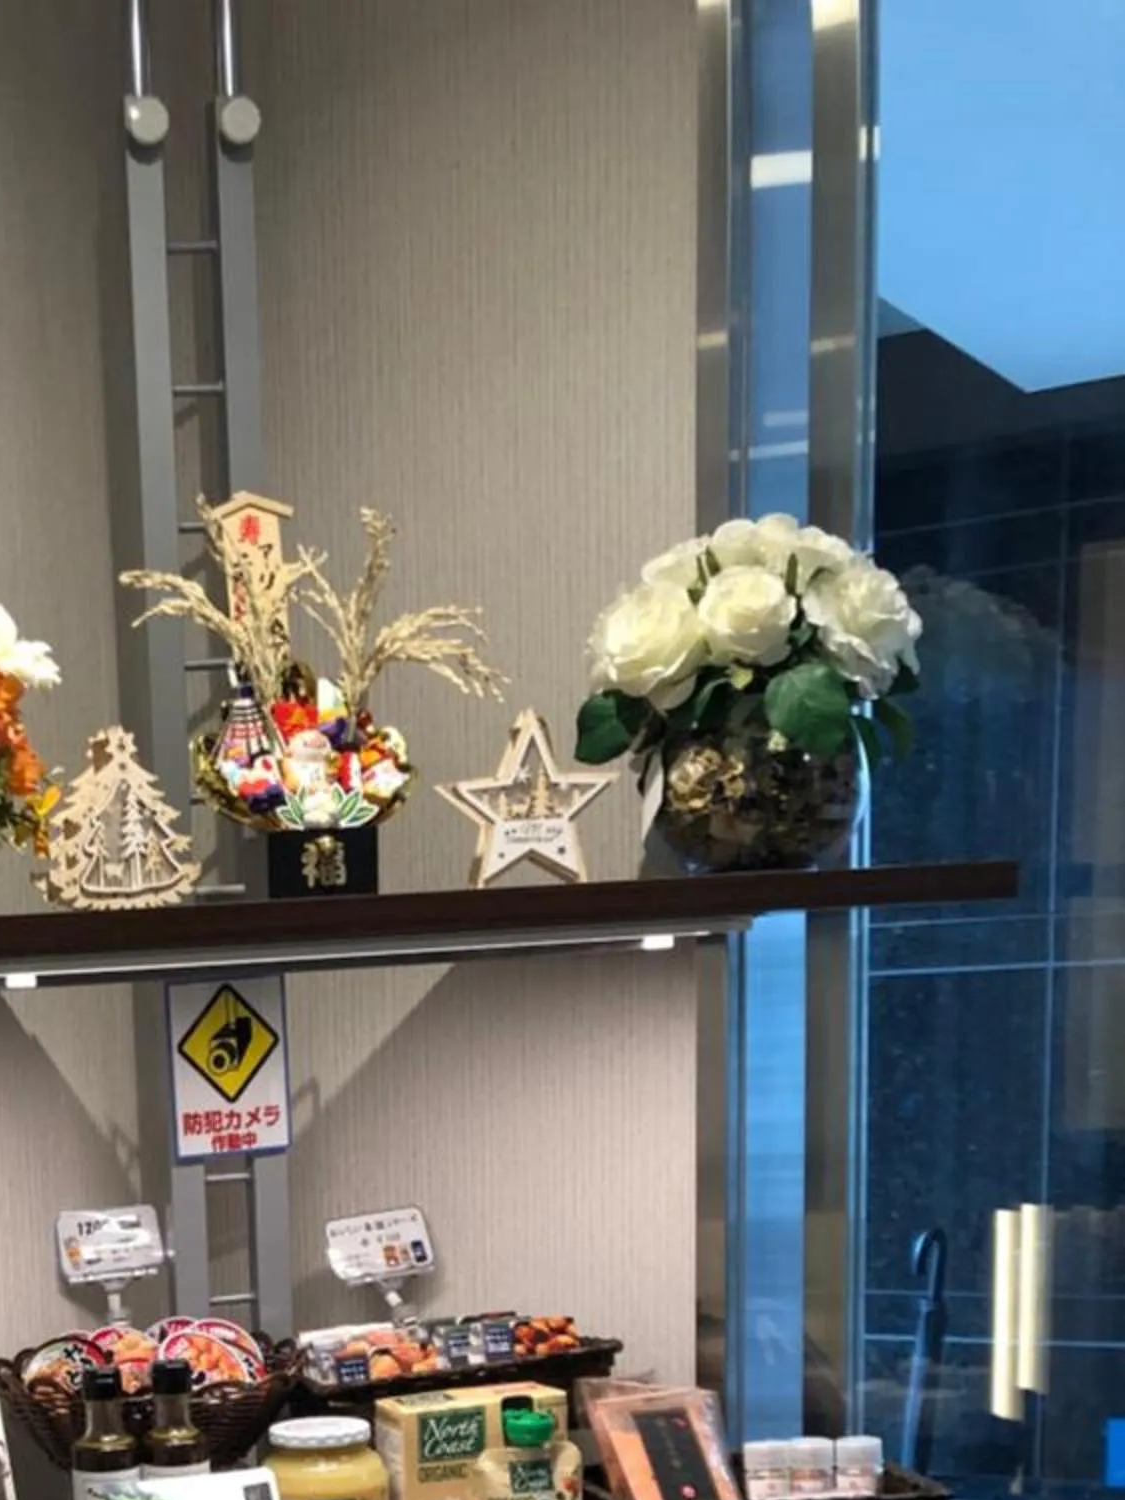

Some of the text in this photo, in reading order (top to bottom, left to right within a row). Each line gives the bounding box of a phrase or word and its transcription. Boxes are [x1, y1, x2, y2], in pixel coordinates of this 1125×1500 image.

[183, 1105, 281, 1136] 防犯カメラ
[211, 1132, 258, 1153] 作動中
[424, 1414, 483, 1442] North
[419, 1464, 467, 1483] ORGANIC
